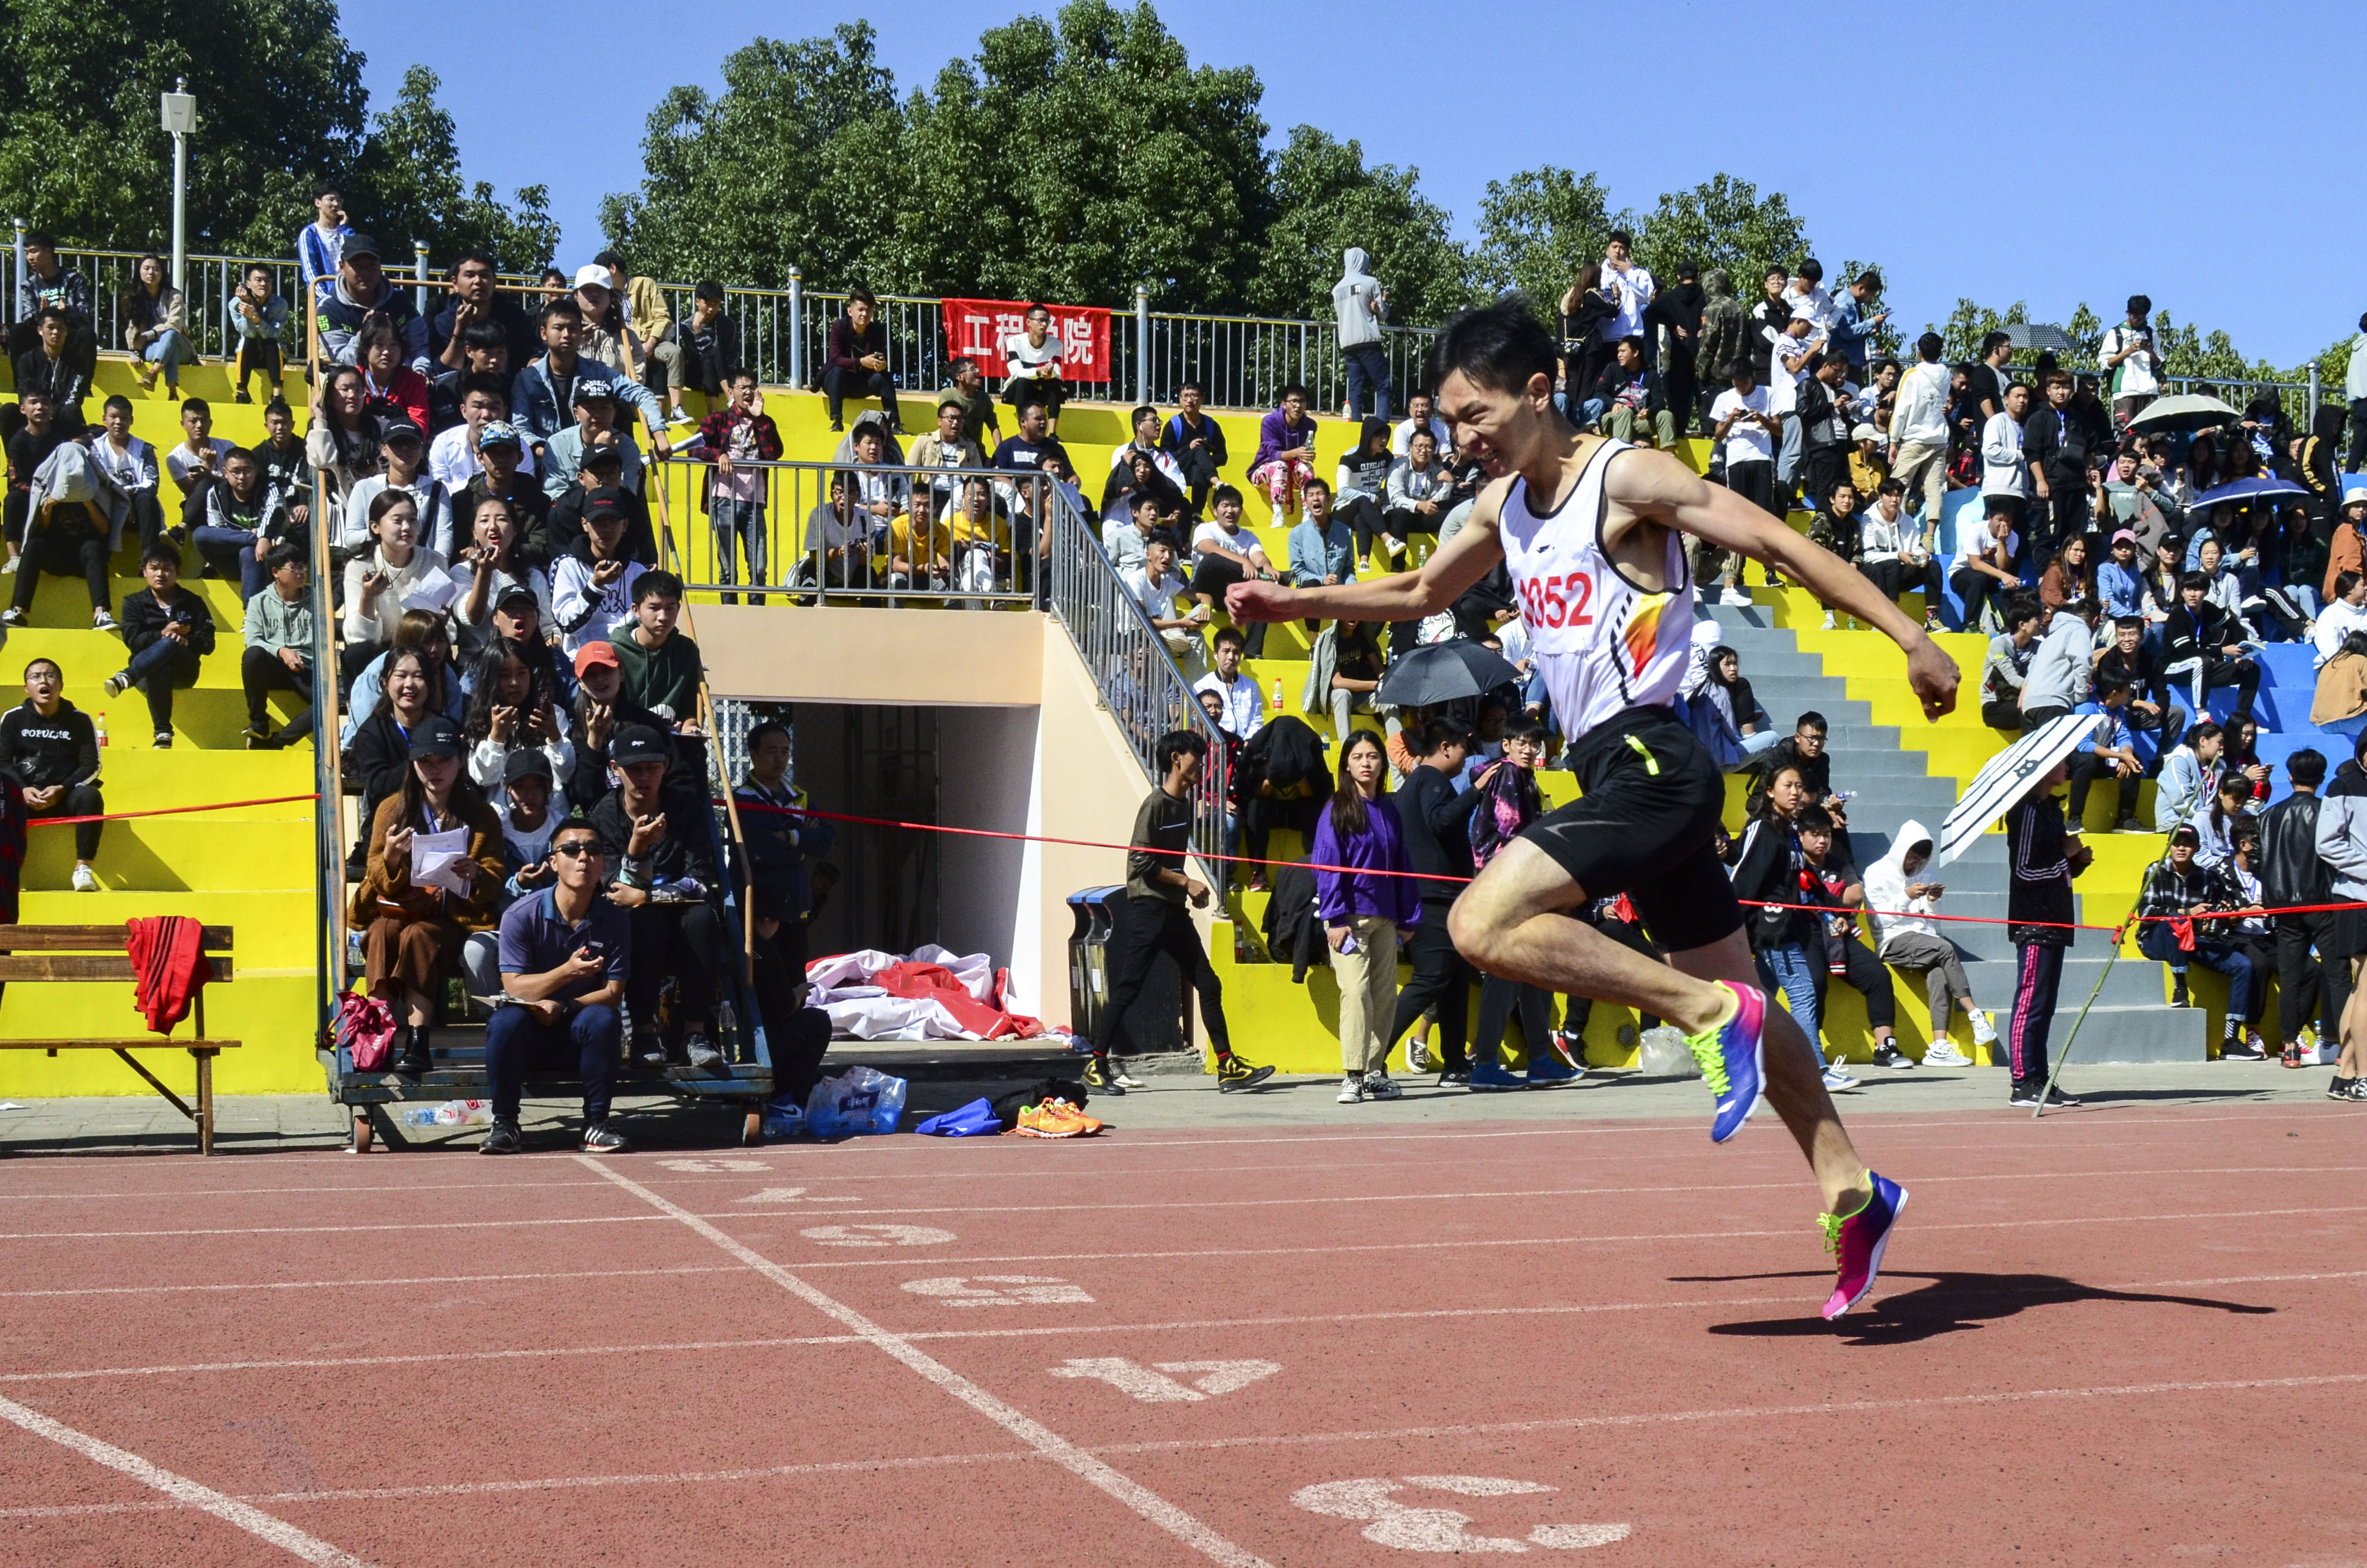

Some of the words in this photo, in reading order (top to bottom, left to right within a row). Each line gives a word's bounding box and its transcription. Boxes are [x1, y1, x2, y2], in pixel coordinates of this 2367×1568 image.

[963, 313, 1093, 365] 工程院
[900, 1275, 1096, 1308] 5
[1047, 1356, 1283, 1403] 4
[1290, 1475, 1633, 1554] 3
